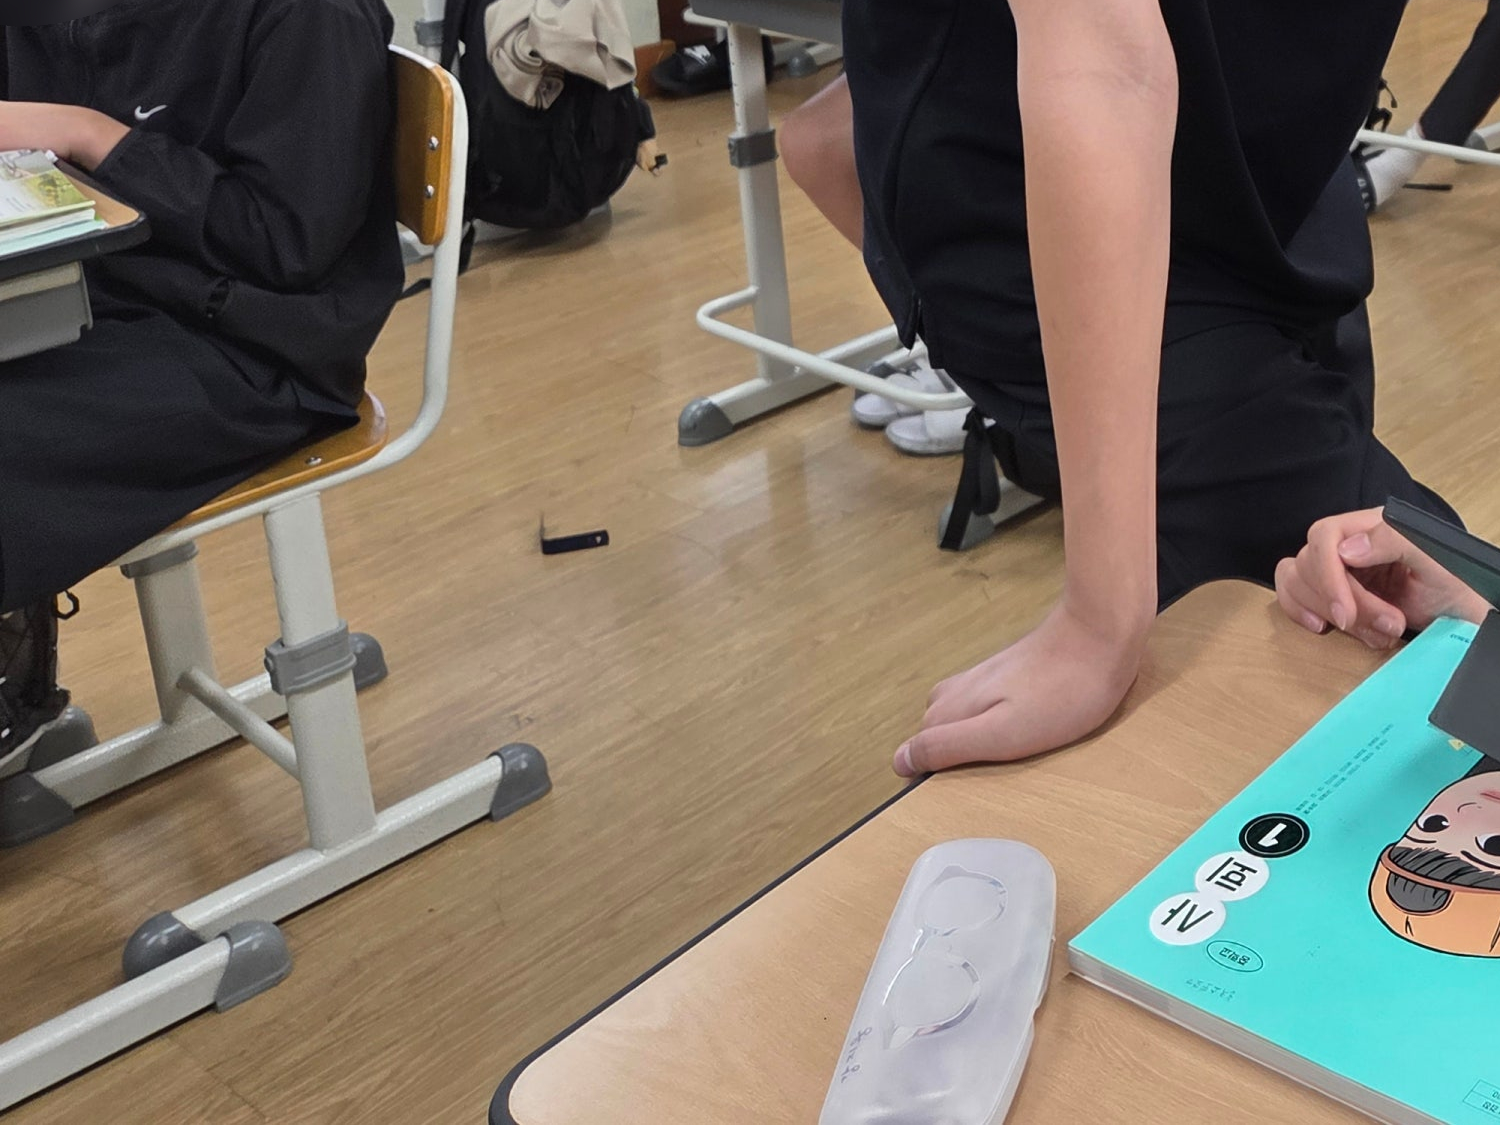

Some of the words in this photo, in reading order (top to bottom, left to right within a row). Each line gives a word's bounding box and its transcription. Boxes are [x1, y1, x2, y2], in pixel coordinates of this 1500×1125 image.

[1160, 856, 1257, 934] 사회
[1257, 822, 1288, 848] 1
[1219, 946, 1251, 966] 중학교
